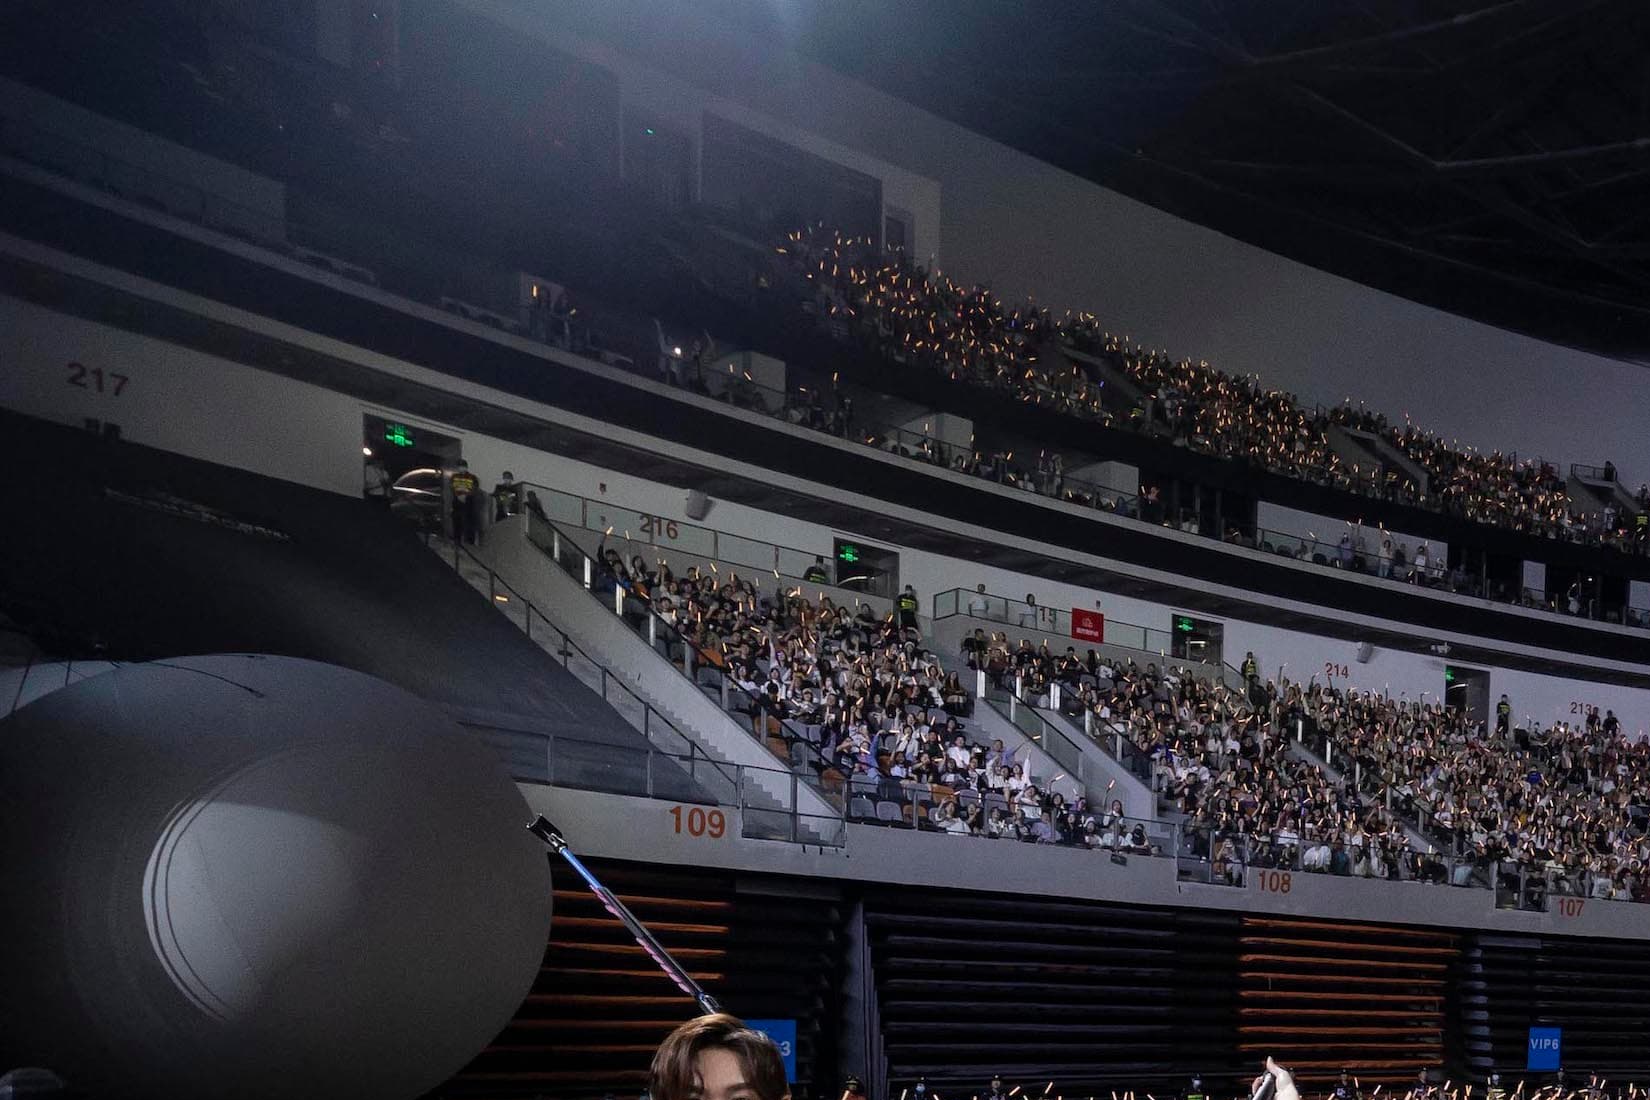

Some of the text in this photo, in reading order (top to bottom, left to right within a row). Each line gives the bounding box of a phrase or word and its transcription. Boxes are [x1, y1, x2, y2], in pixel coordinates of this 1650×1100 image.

[67, 362, 129, 396] 217
[640, 514, 678, 539] 216
[1325, 662, 1349, 679] 214
[1570, 701, 1592, 716] 213
[669, 806, 725, 838] 109
[1259, 870, 1291, 893] 108
[1559, 898, 1585, 917] 107
[1530, 1038, 1559, 1050] VIP6
